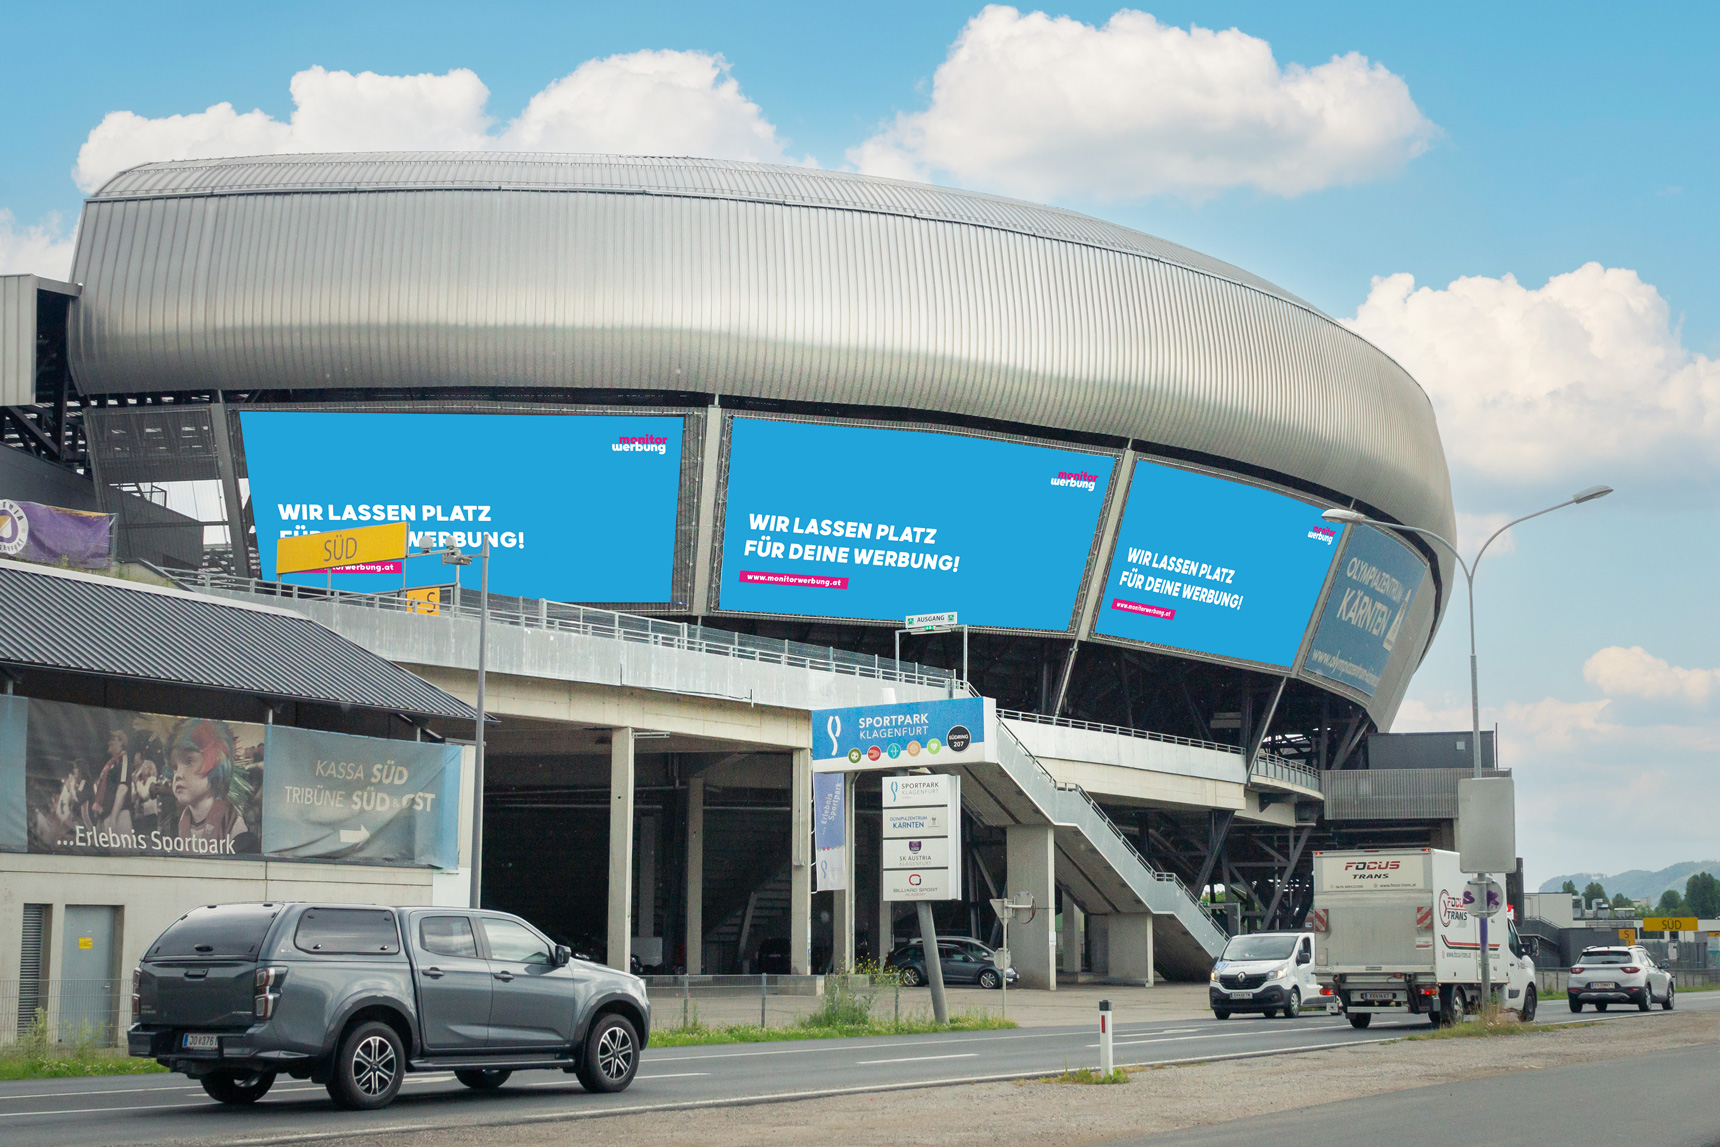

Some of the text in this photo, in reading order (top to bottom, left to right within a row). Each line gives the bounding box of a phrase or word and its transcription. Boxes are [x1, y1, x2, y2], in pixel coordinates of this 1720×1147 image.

[619, 434, 668, 444] monitor
[612, 441, 666, 454] werbung
[1051, 477, 1095, 491] werbung
[1058, 471, 1098, 482] monitor
[277, 504, 491, 522] WIR LASSEN PLATZ
[749, 513, 937, 544] WIR LASSEN PLATZ
[1313, 525, 1336, 537] monitor
[1307, 530, 1333, 545] werbung
[323, 534, 357, 562] SÜD
[744, 535, 960, 572] FÜR DEINE WERBUNG!
[1127, 546, 1235, 584] WIR LASSEN PLATZ
[747, 573, 842, 587] www.monitorwerbung.at
[1119, 567, 1244, 611] FÜR DEINE WERBUNG!
[917, 614, 945, 622] AUSGANG
[1336, 587, 1392, 637] KÄRNTEN
[858, 713, 929, 728] SPORTPARK
[859, 725, 929, 740] KLAGENFURT
[315, 759, 409, 785] KASSA SÜD
[285, 784, 345, 808] TRIBÜNE
[351, 785, 390, 812] SÜD
[901, 788, 939, 796] KLAGENFURT
[820, 792, 833, 825] Erlebnis
[828, 781, 842, 822] Sportpark
[151, 830, 236, 855] Sportpark
[1344, 861, 1401, 871] FOCUS
[1447, 896, 1464, 908] FOCU
[1447, 910, 1468, 921] TRANS
[1661, 918, 1682, 930] SÜD
